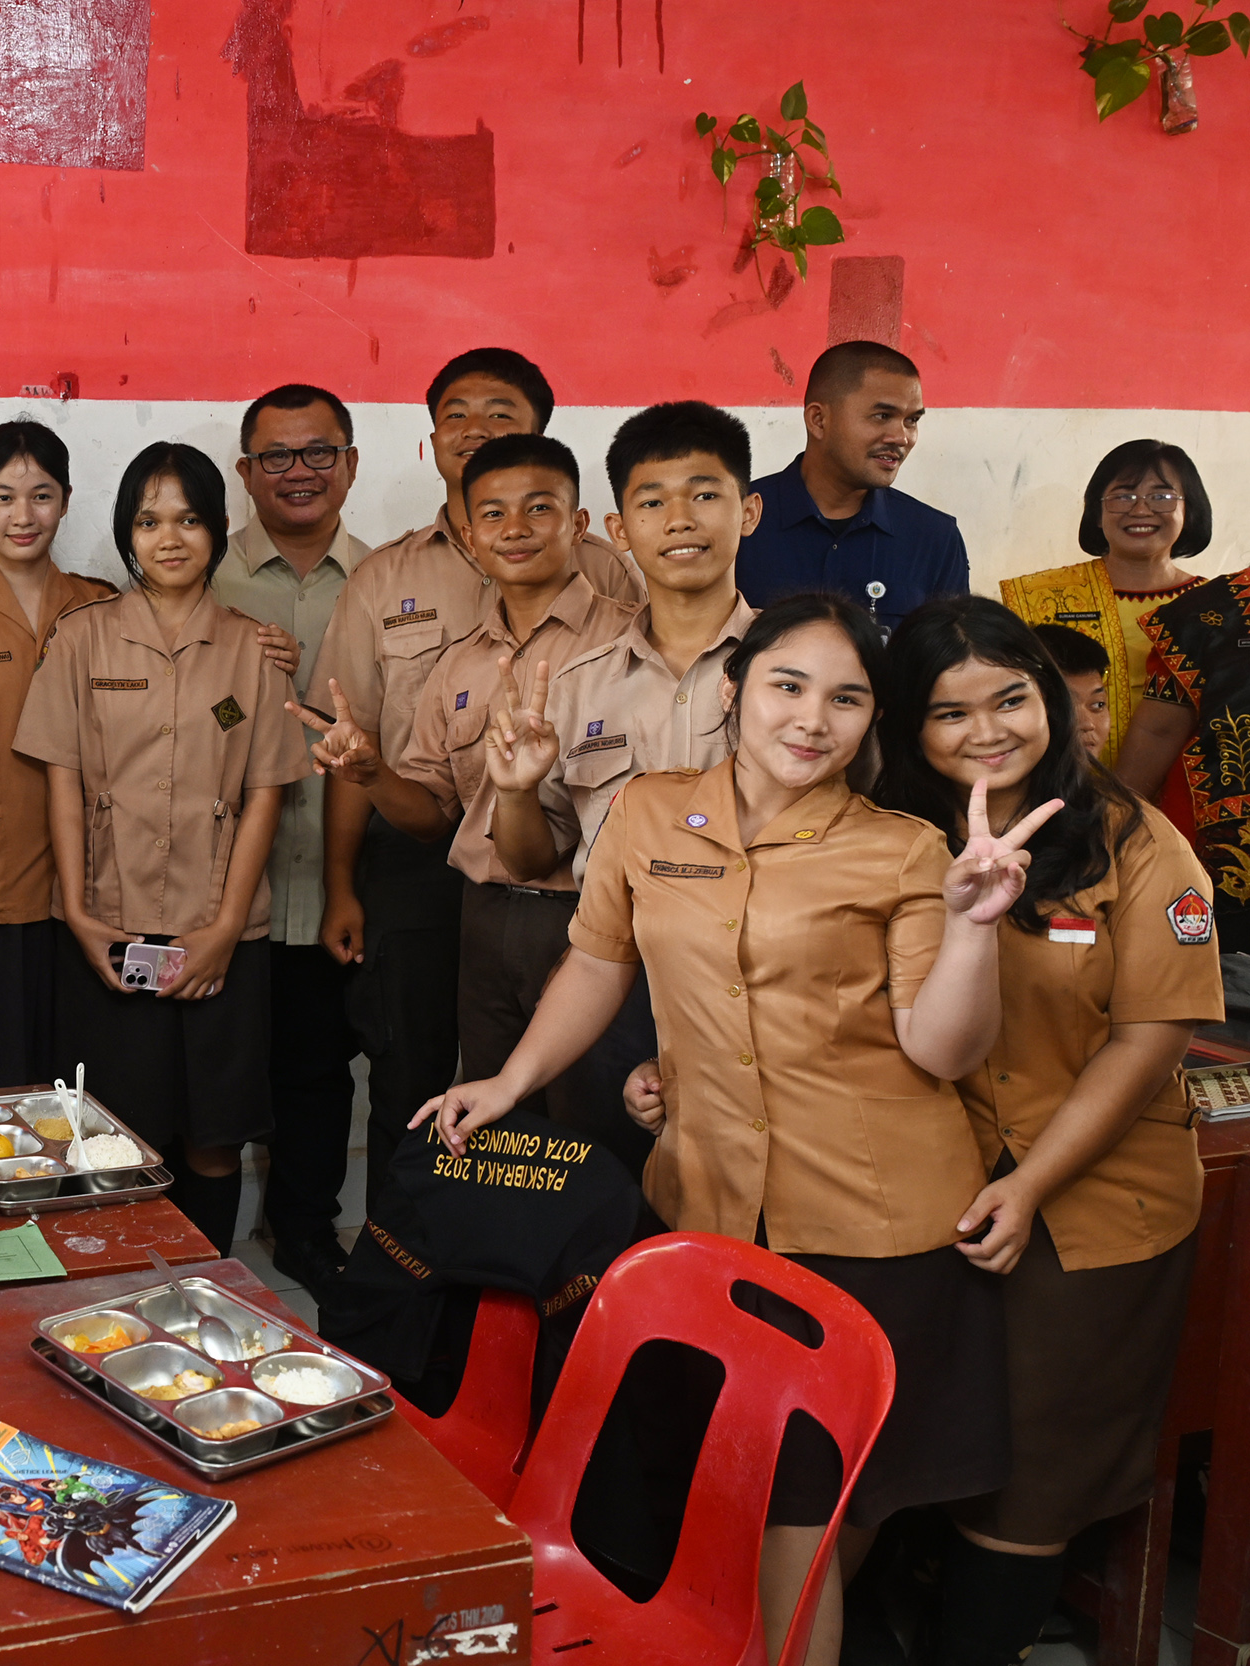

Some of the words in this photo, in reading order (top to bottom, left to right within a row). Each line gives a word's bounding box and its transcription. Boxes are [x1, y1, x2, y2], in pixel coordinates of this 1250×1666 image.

[544, 1137, 592, 1164] KOTA
[433, 1153, 472, 1181] 2025
[477, 1160, 568, 1191] PASKIBRAKA
